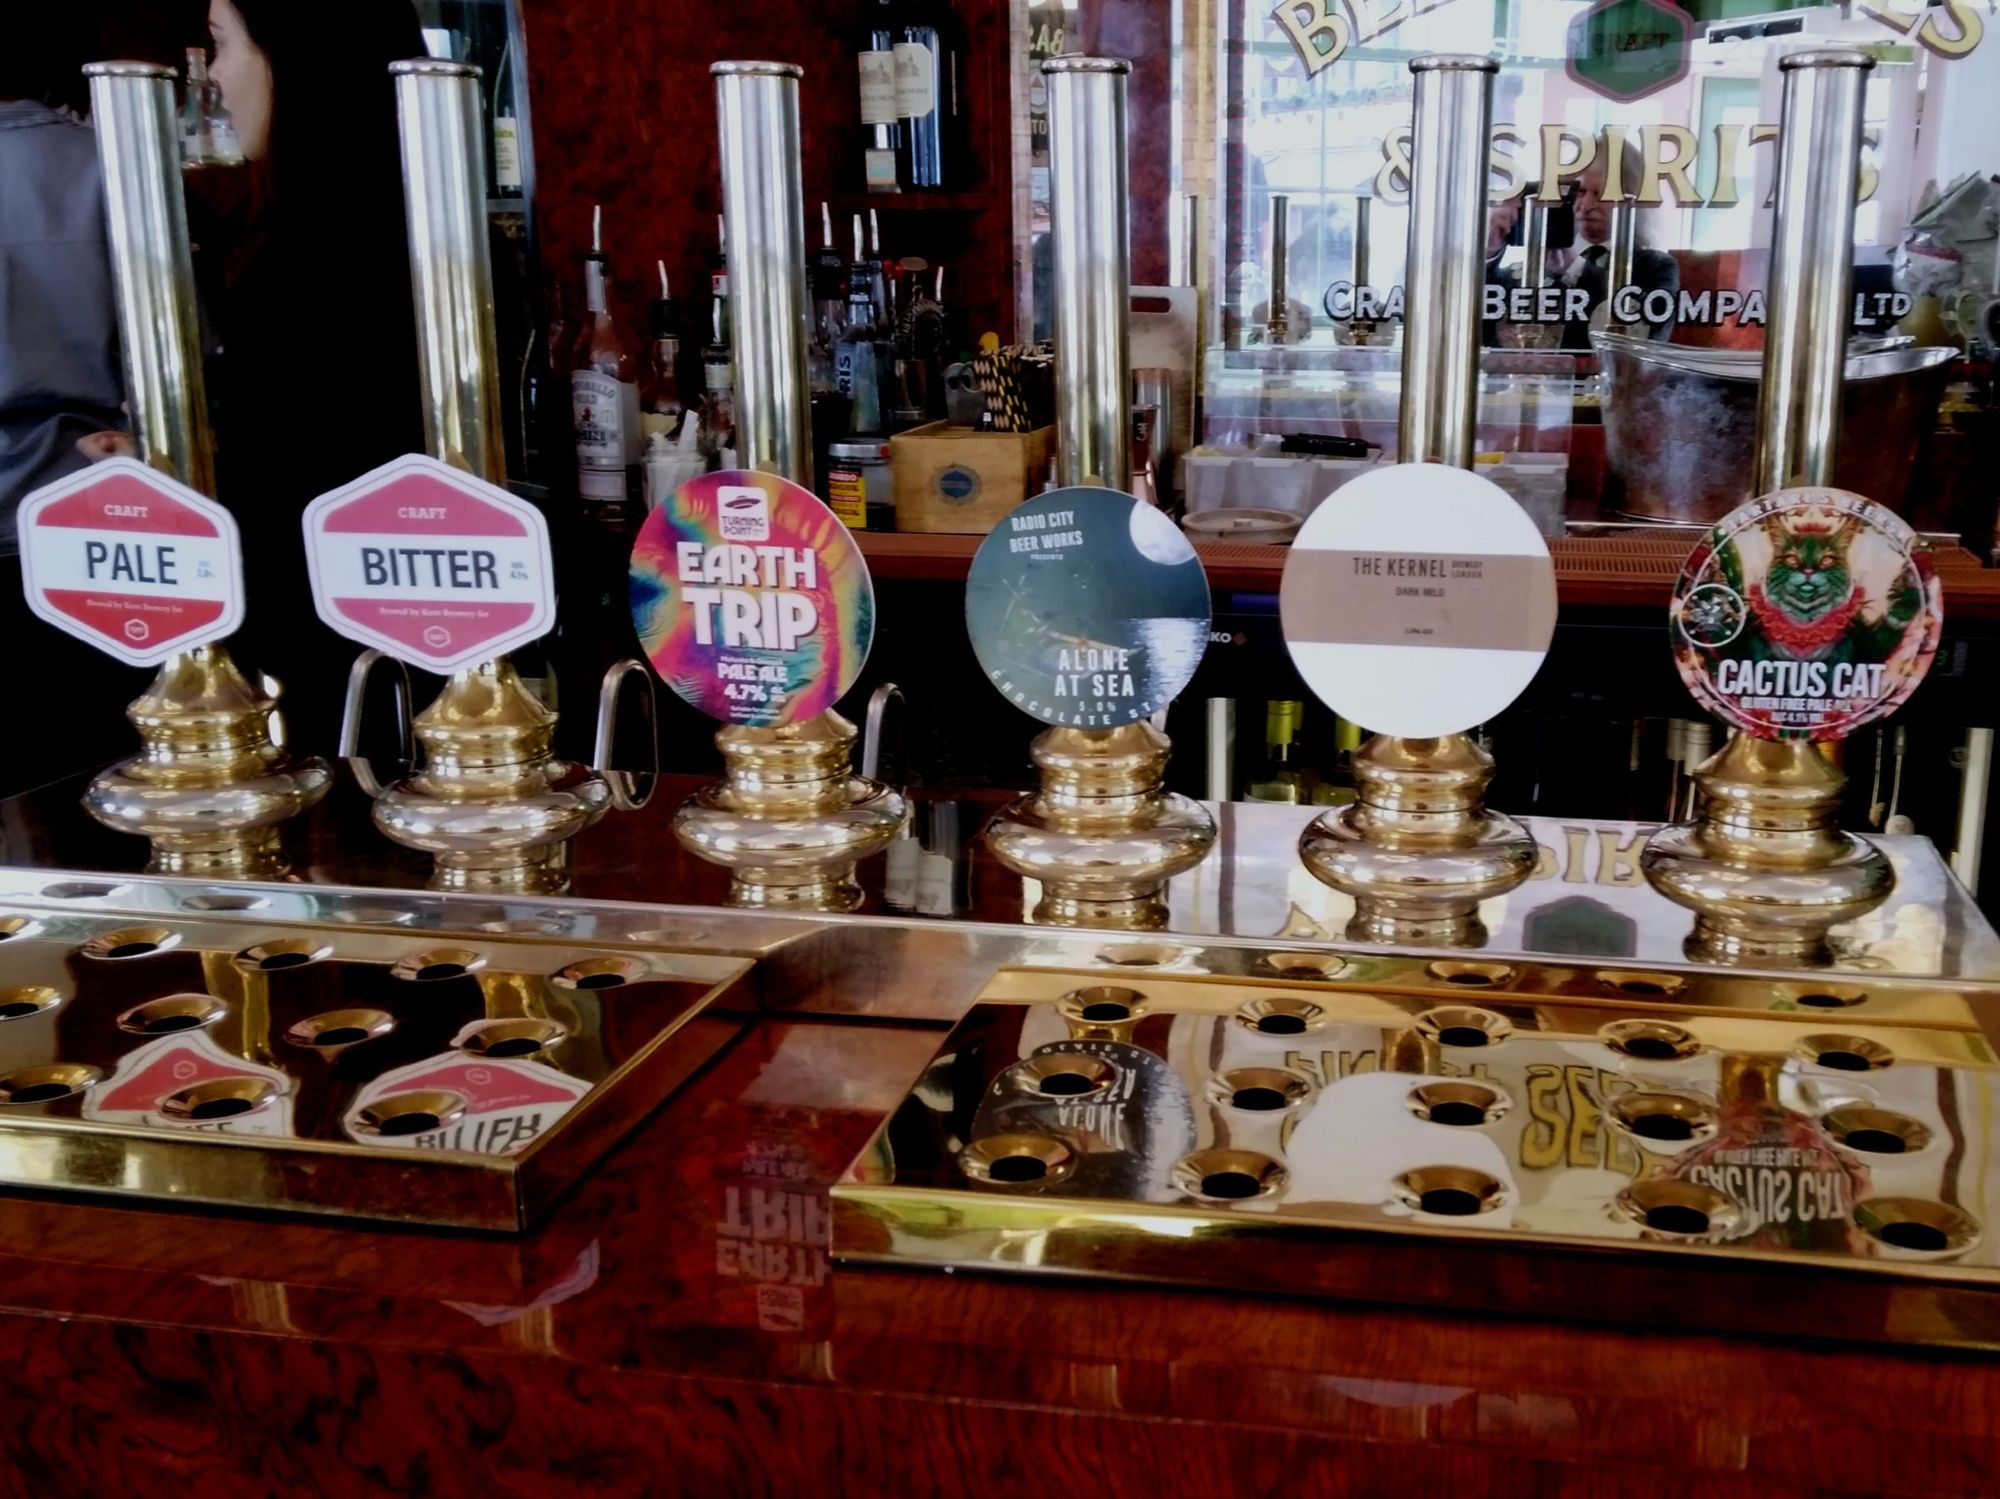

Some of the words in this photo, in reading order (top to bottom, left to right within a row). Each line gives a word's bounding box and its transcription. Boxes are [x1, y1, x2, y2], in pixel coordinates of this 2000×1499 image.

[1324, 281, 1404, 321] CRA
[1483, 285, 1591, 324] BEER
[1614, 284, 1767, 325] COMPA
[1853, 291, 1913, 327] LTD
[104, 504, 149, 518] CRAFT
[397, 506, 447, 520] CRAFT
[721, 516, 764, 527] TURNING
[1010, 514, 1046, 532] RADIO
[1048, 510, 1075, 528] CITY
[724, 526, 753, 536] POINT
[1009, 535, 1040, 553] BEER
[1041, 530, 1083, 549] WORKS
[85, 541, 179, 585] PALE
[361, 547, 499, 589] BITTER
[676, 541, 818, 589] EARTH
[1352, 557, 1381, 576] THE
[1386, 558, 1448, 579] KERNEL
[1395, 586, 1420, 597] DARK
[1423, 587, 1445, 598] MILD
[681, 586, 819, 650] TRIP
[1058, 649, 1130, 671] ALONE
[717, 662, 757, 681] PALE
[758, 665, 789, 683] ALE
[1716, 659, 1827, 697] CACTUS
[1831, 663, 1887, 699] CAT
[724, 683, 768, 702] 4.7%
[1054, 674, 1081, 697] AT
[1093, 674, 1135, 697] SEA
[991, 669, 1112, 726] CHOCOLATE
